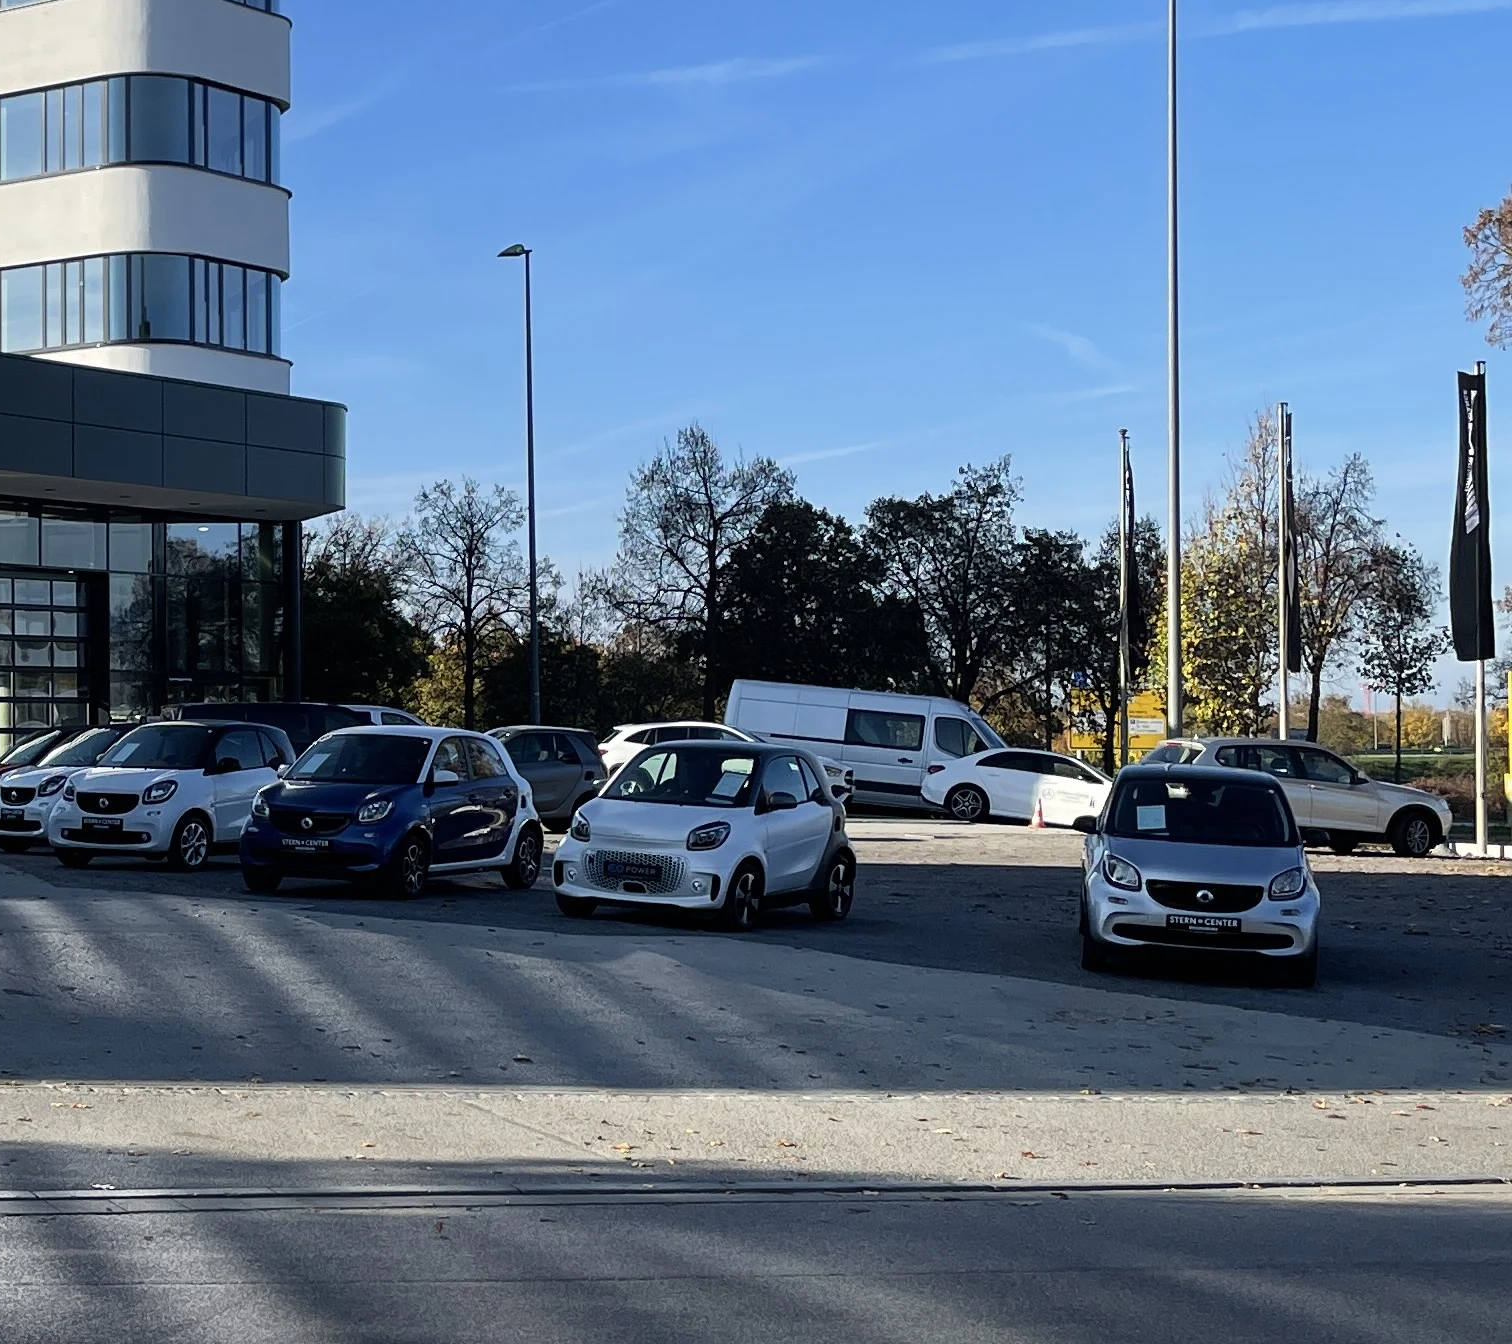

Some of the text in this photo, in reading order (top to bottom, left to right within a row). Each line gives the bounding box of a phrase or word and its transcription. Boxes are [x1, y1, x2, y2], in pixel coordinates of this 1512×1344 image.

[305, 839, 329, 847] CENTER
[625, 865, 656, 875] POWER
[1169, 915, 1238, 927] STERN CENTER
